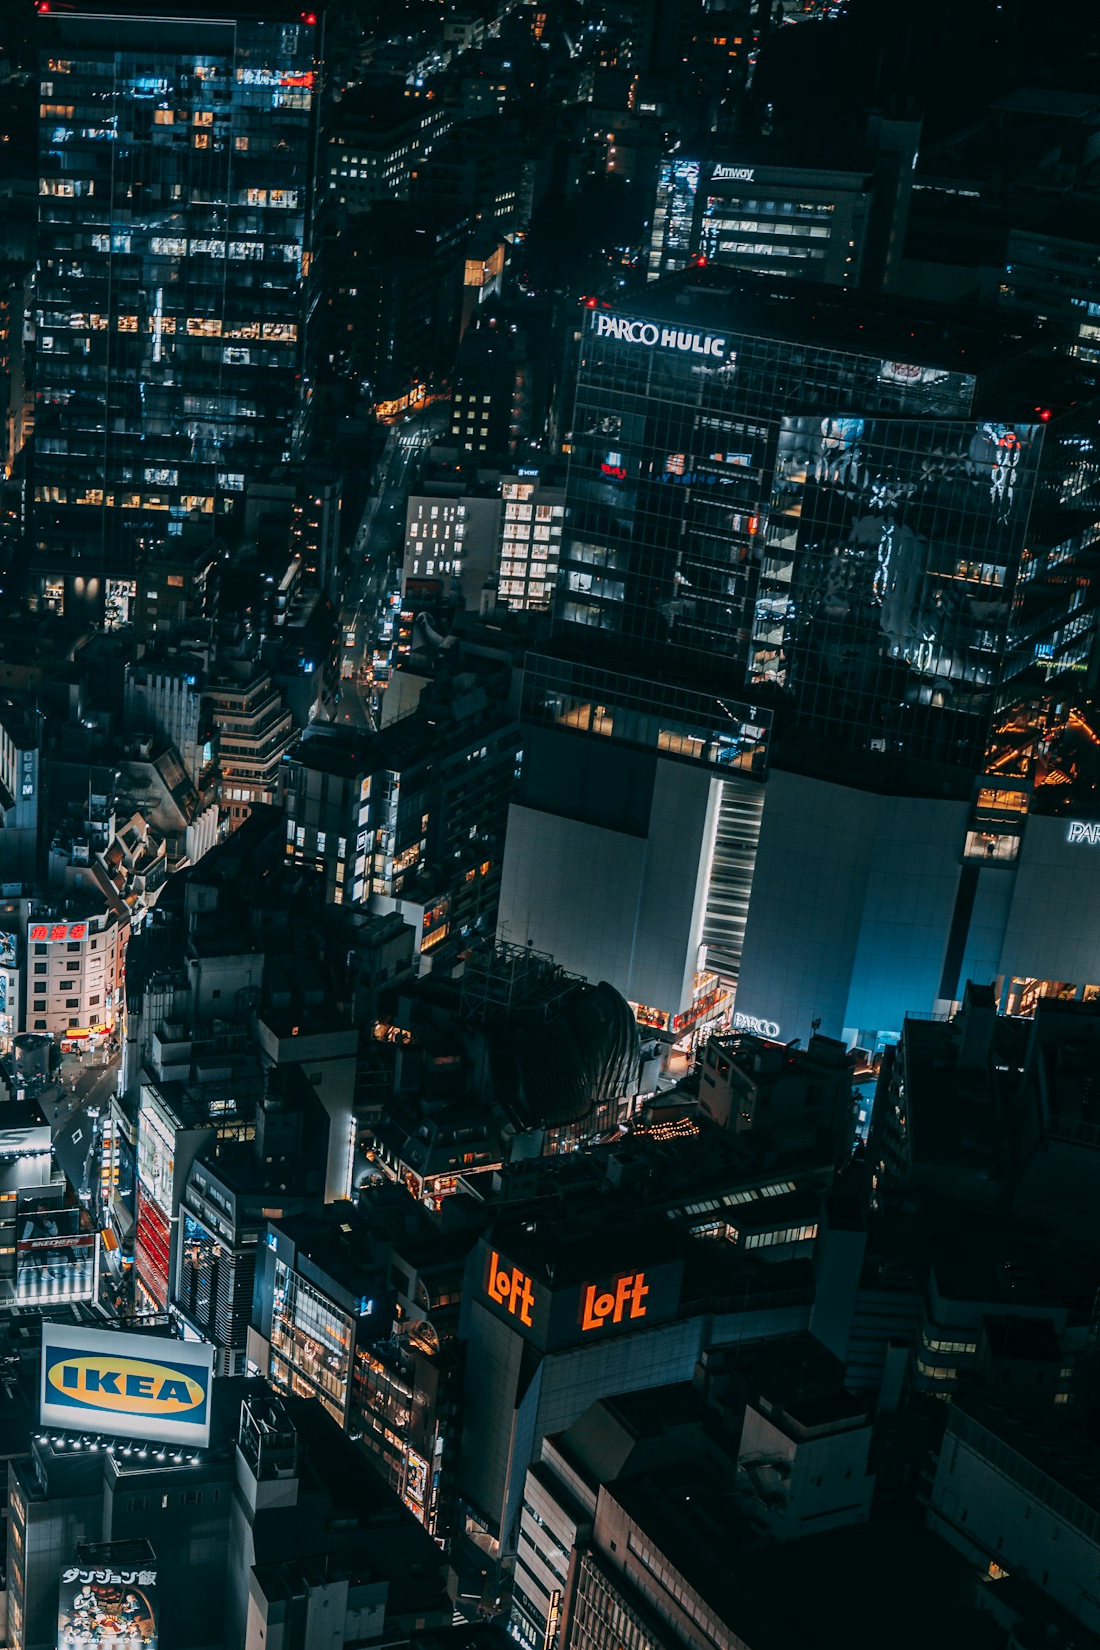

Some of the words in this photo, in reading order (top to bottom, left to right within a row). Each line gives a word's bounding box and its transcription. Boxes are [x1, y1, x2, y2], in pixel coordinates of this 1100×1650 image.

[713, 164, 753, 179] Amway
[597, 315, 658, 345] PARCO
[661, 329, 726, 357] HULIC
[21, 751, 34, 796] BEAM
[734, 1012, 780, 1037] PARCO
[31, 1237, 81, 1249] SKECHERS
[62, 1365, 194, 1405] IKEA
[62, 1567, 158, 1586] ダンジョン飯
